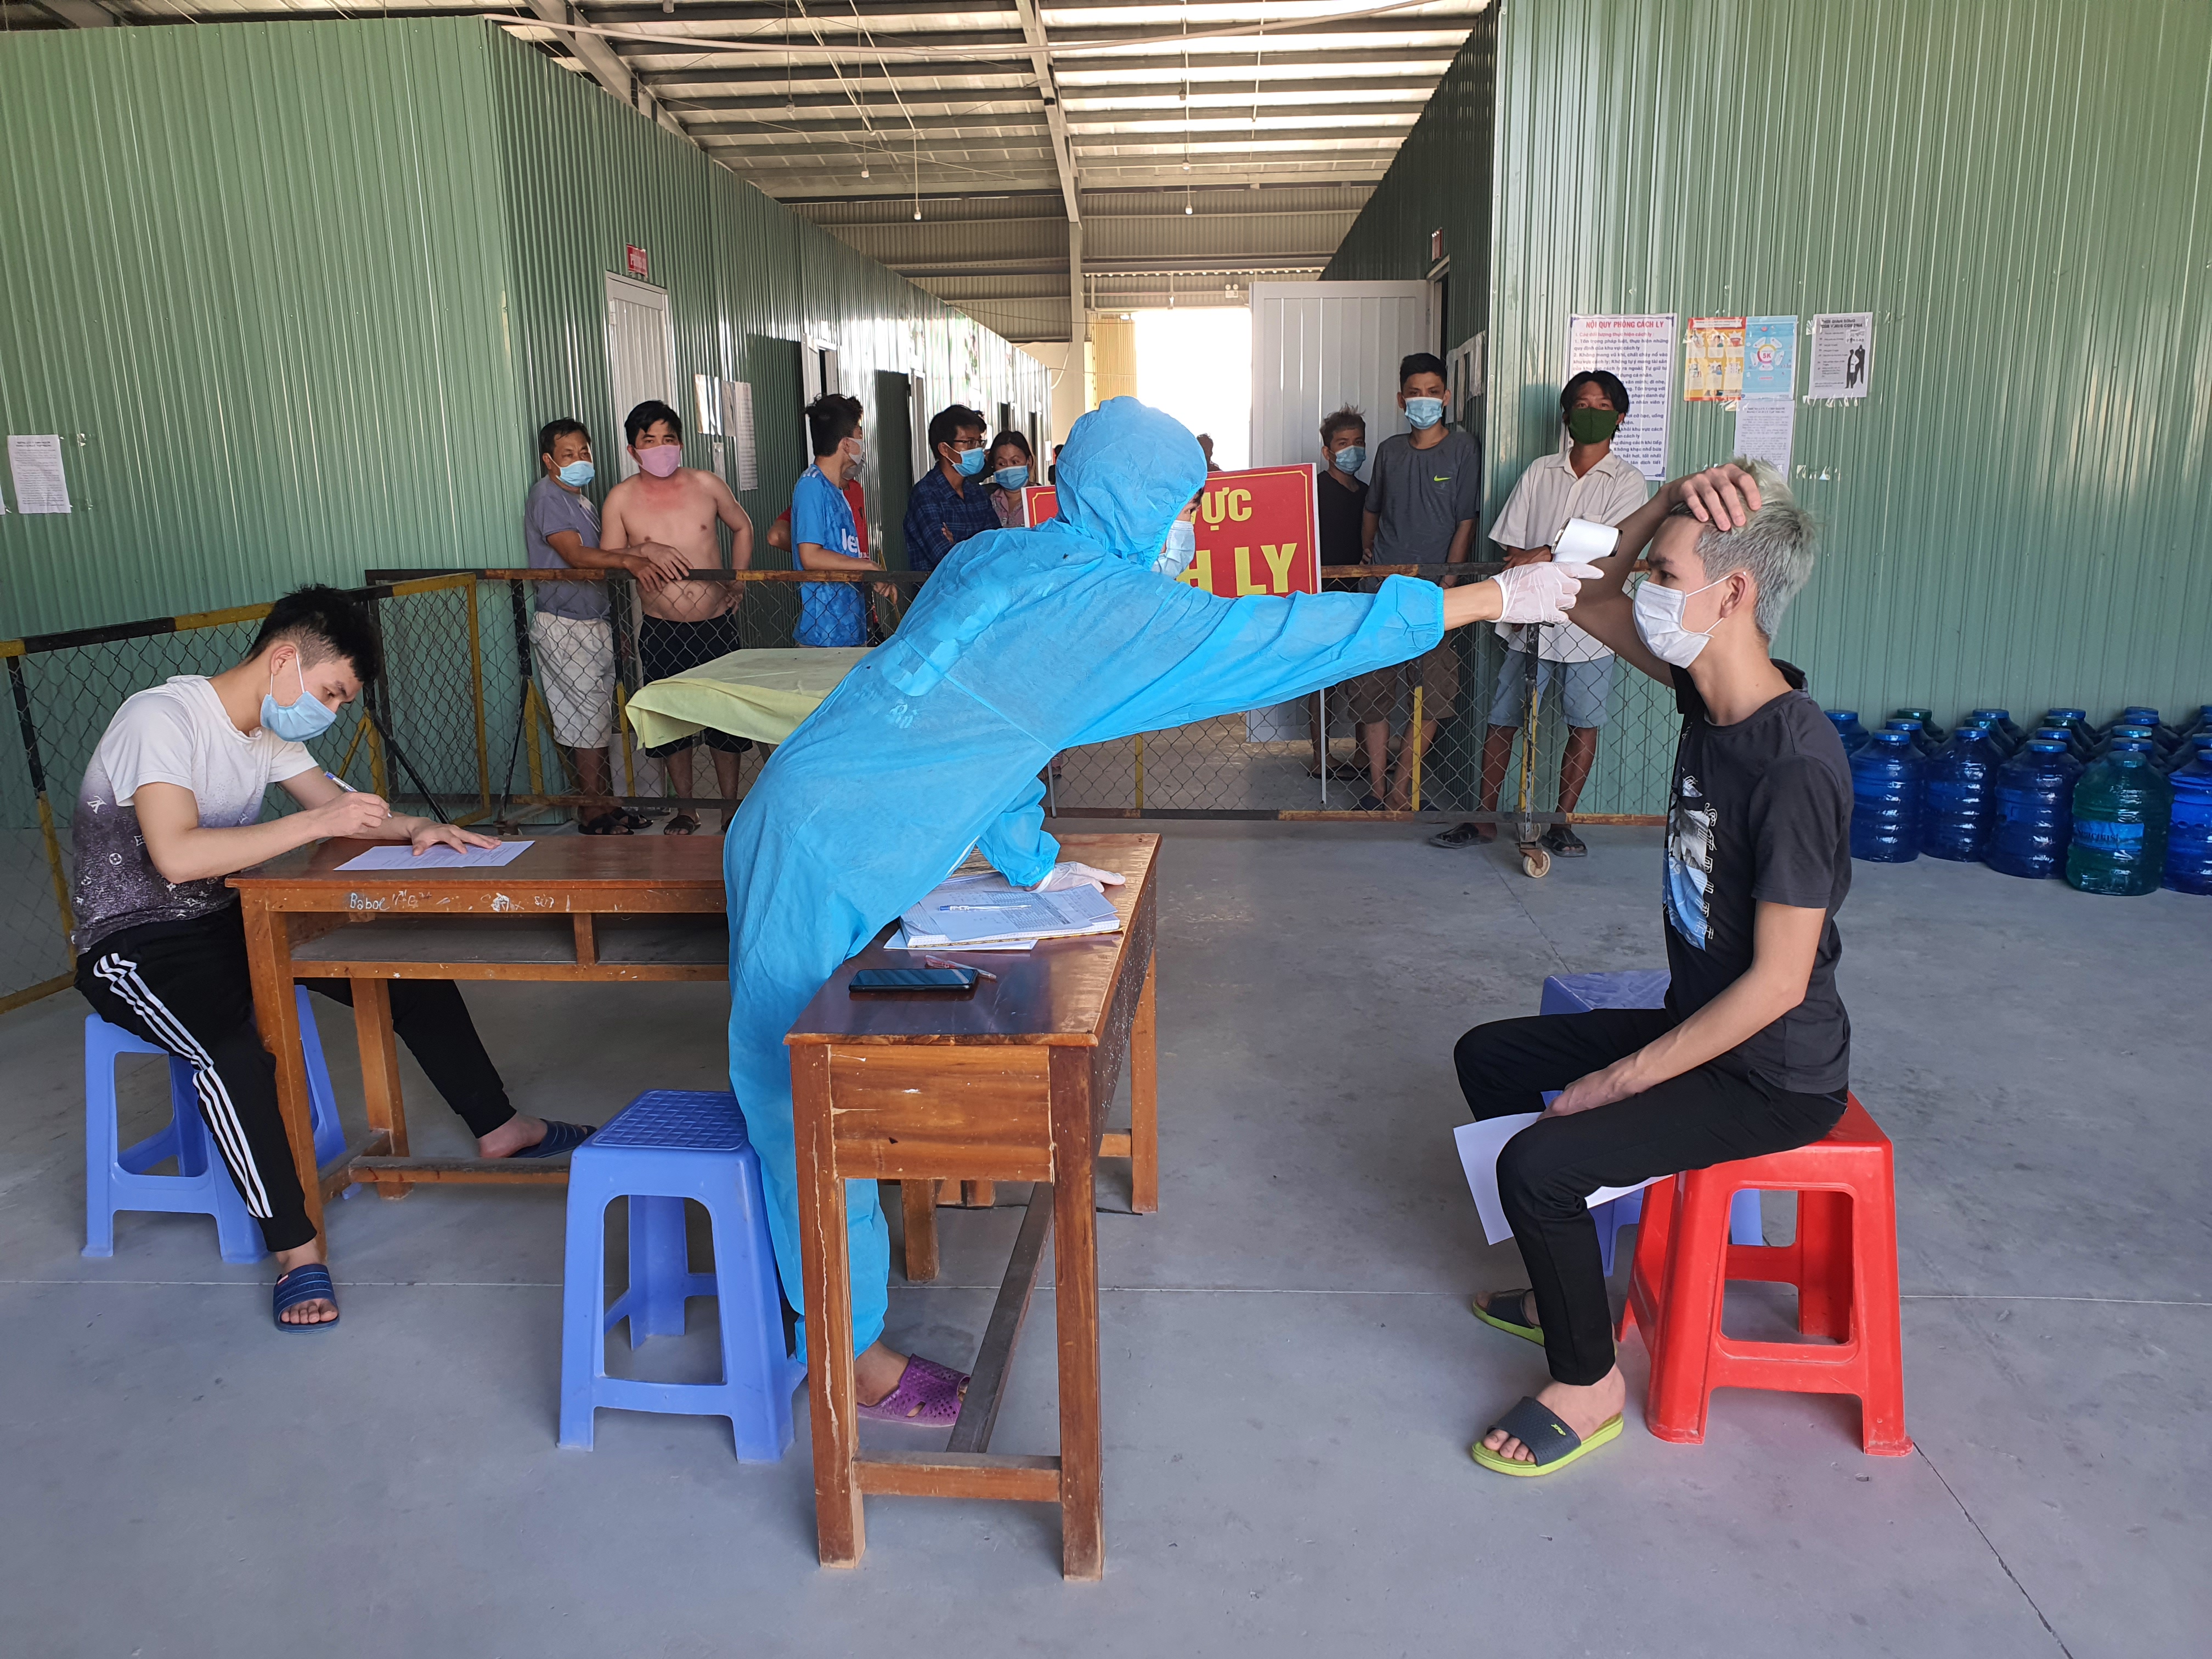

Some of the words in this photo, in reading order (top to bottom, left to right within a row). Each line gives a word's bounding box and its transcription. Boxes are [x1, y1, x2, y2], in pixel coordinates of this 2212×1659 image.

[1586, 320, 1597, 329] NỘI
[1599, 321, 1611, 329] QUY
[1613, 320, 1635, 328] PHÒNG
[1637, 319, 1654, 328] CÁCH
[1234, 543, 1297, 596] LY
